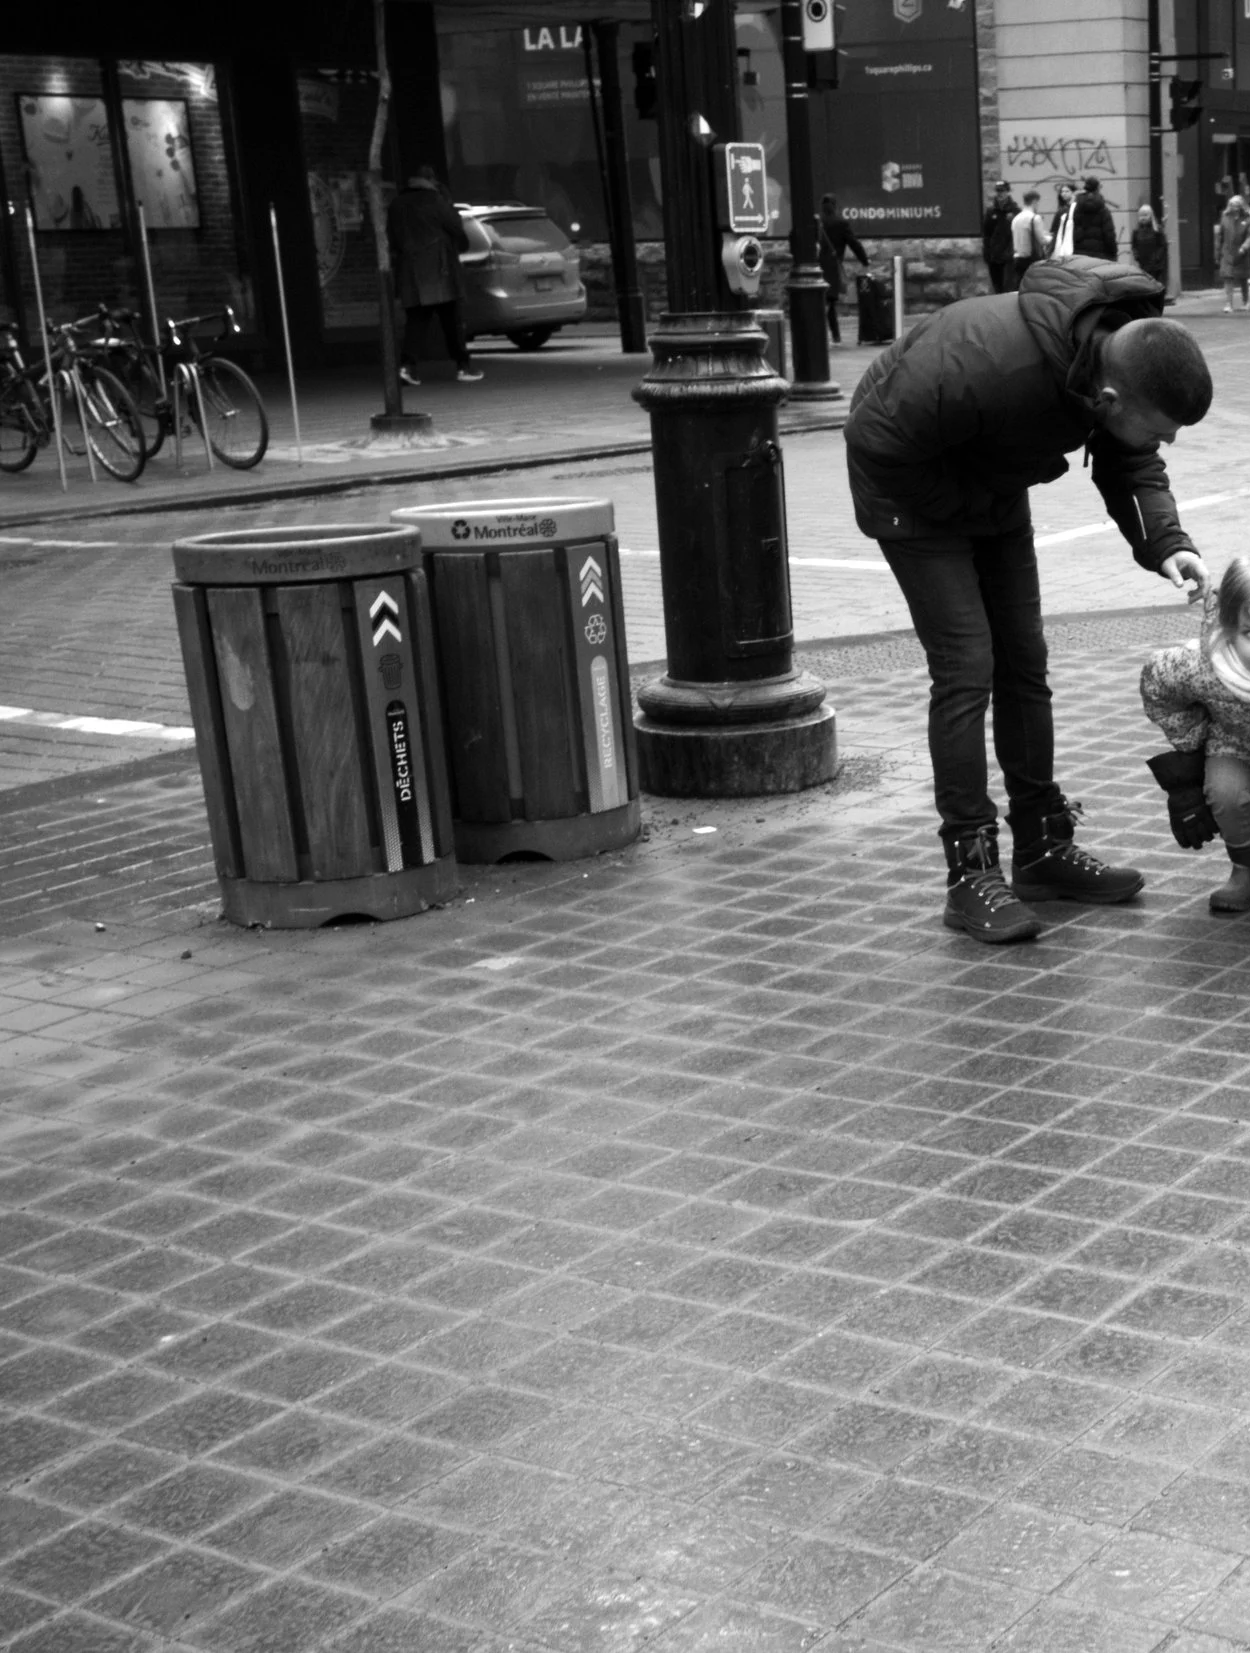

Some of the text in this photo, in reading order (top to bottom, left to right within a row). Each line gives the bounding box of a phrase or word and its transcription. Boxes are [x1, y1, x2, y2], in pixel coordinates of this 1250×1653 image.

[523, 26, 556, 51] LA
[842, 205, 942, 219] CONDOMINIUMS
[474, 522, 539, 540] Montréal
[596, 675, 613, 769] RECYCLAGE
[392, 720, 412, 801] DÉCHETS
